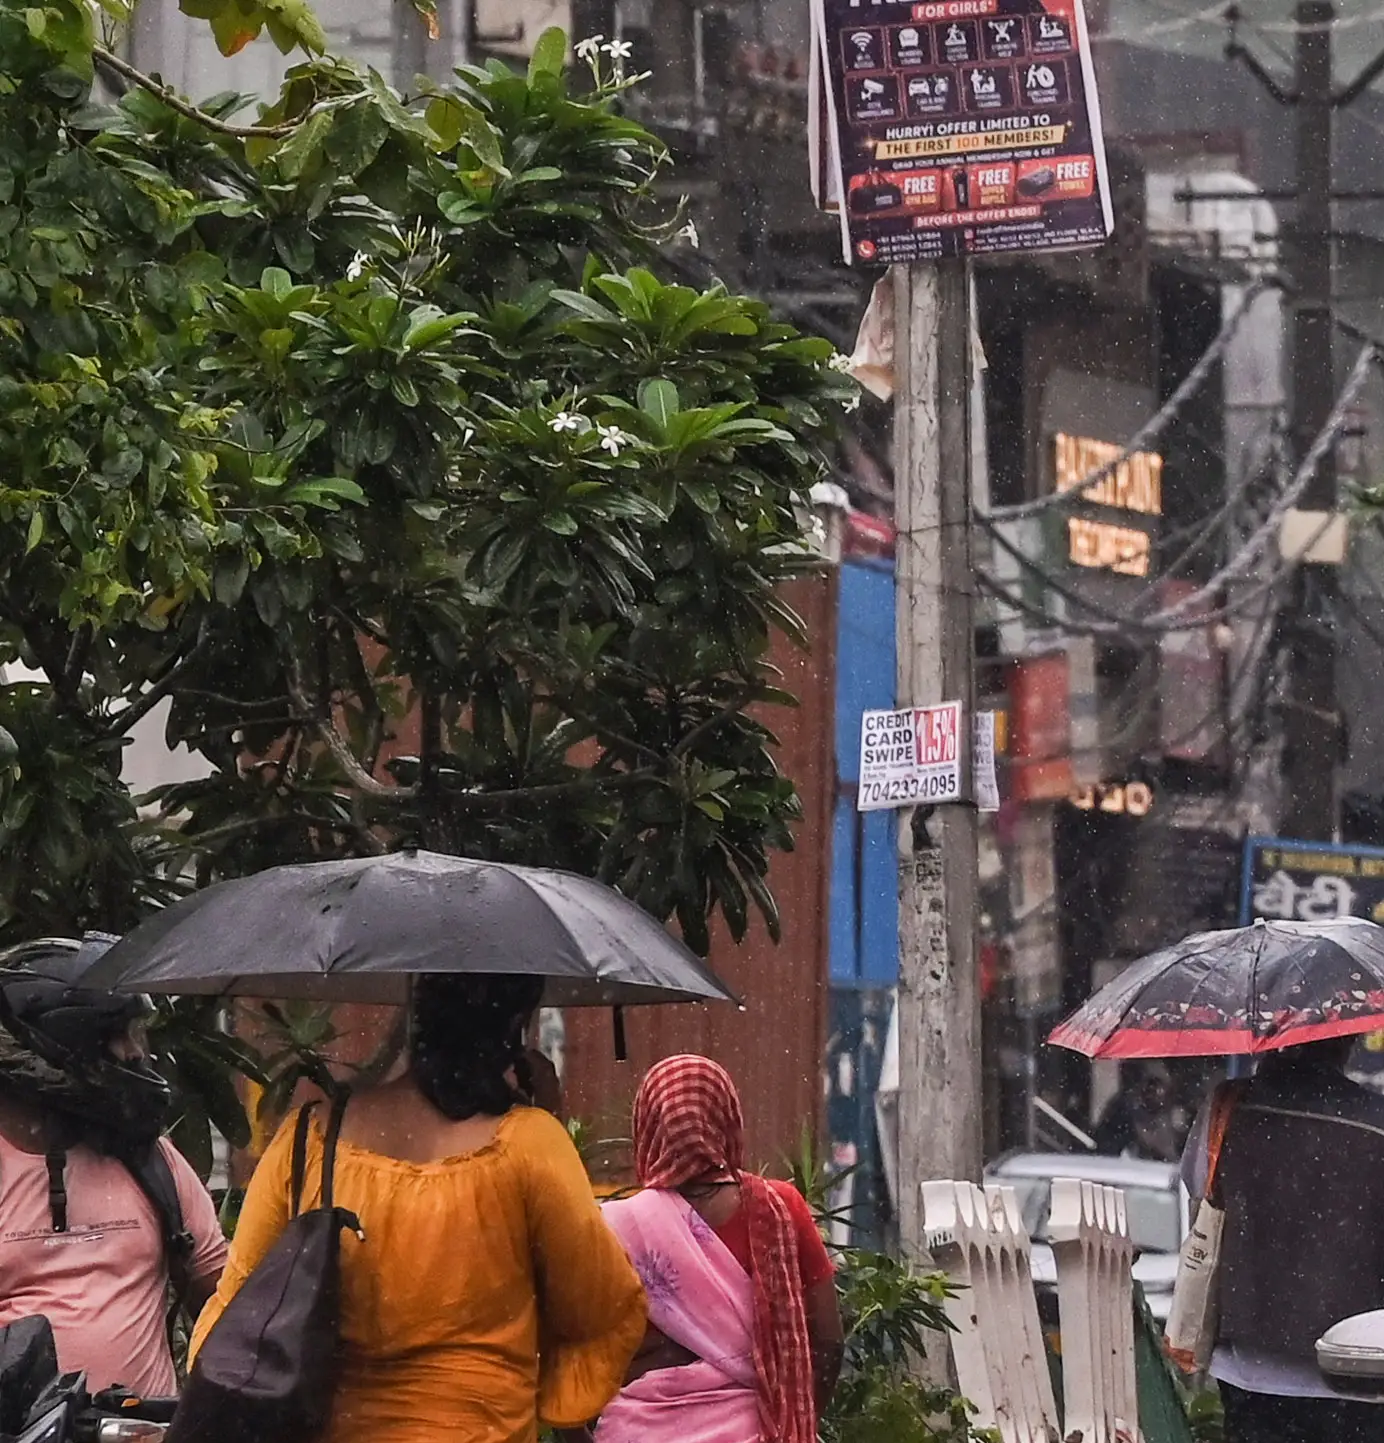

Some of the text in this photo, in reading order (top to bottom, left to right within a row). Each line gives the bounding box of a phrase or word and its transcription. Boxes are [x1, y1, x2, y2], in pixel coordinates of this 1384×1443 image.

[917, 6, 945, 18] FOR
[886, 114, 1050, 139] HURRY! OFFER LIMITED TO
[886, 131, 1054, 155] THE FIRST 100 MEMBERS!
[978, 168, 1011, 186] FREE
[1056, 161, 1090, 179] FREE
[903, 175, 936, 194] FREE
[917, 215, 953, 227] BEFORE
[957, 213, 974, 223] THE
[976, 210, 1005, 221] OFFER
[866, 711, 912, 730] CREDIT
[865, 729, 913, 747] CARD
[916, 712, 956, 762] 1.5%
[864, 746, 913, 764] SWIPE
[863, 774, 956, 803] 7042334095
